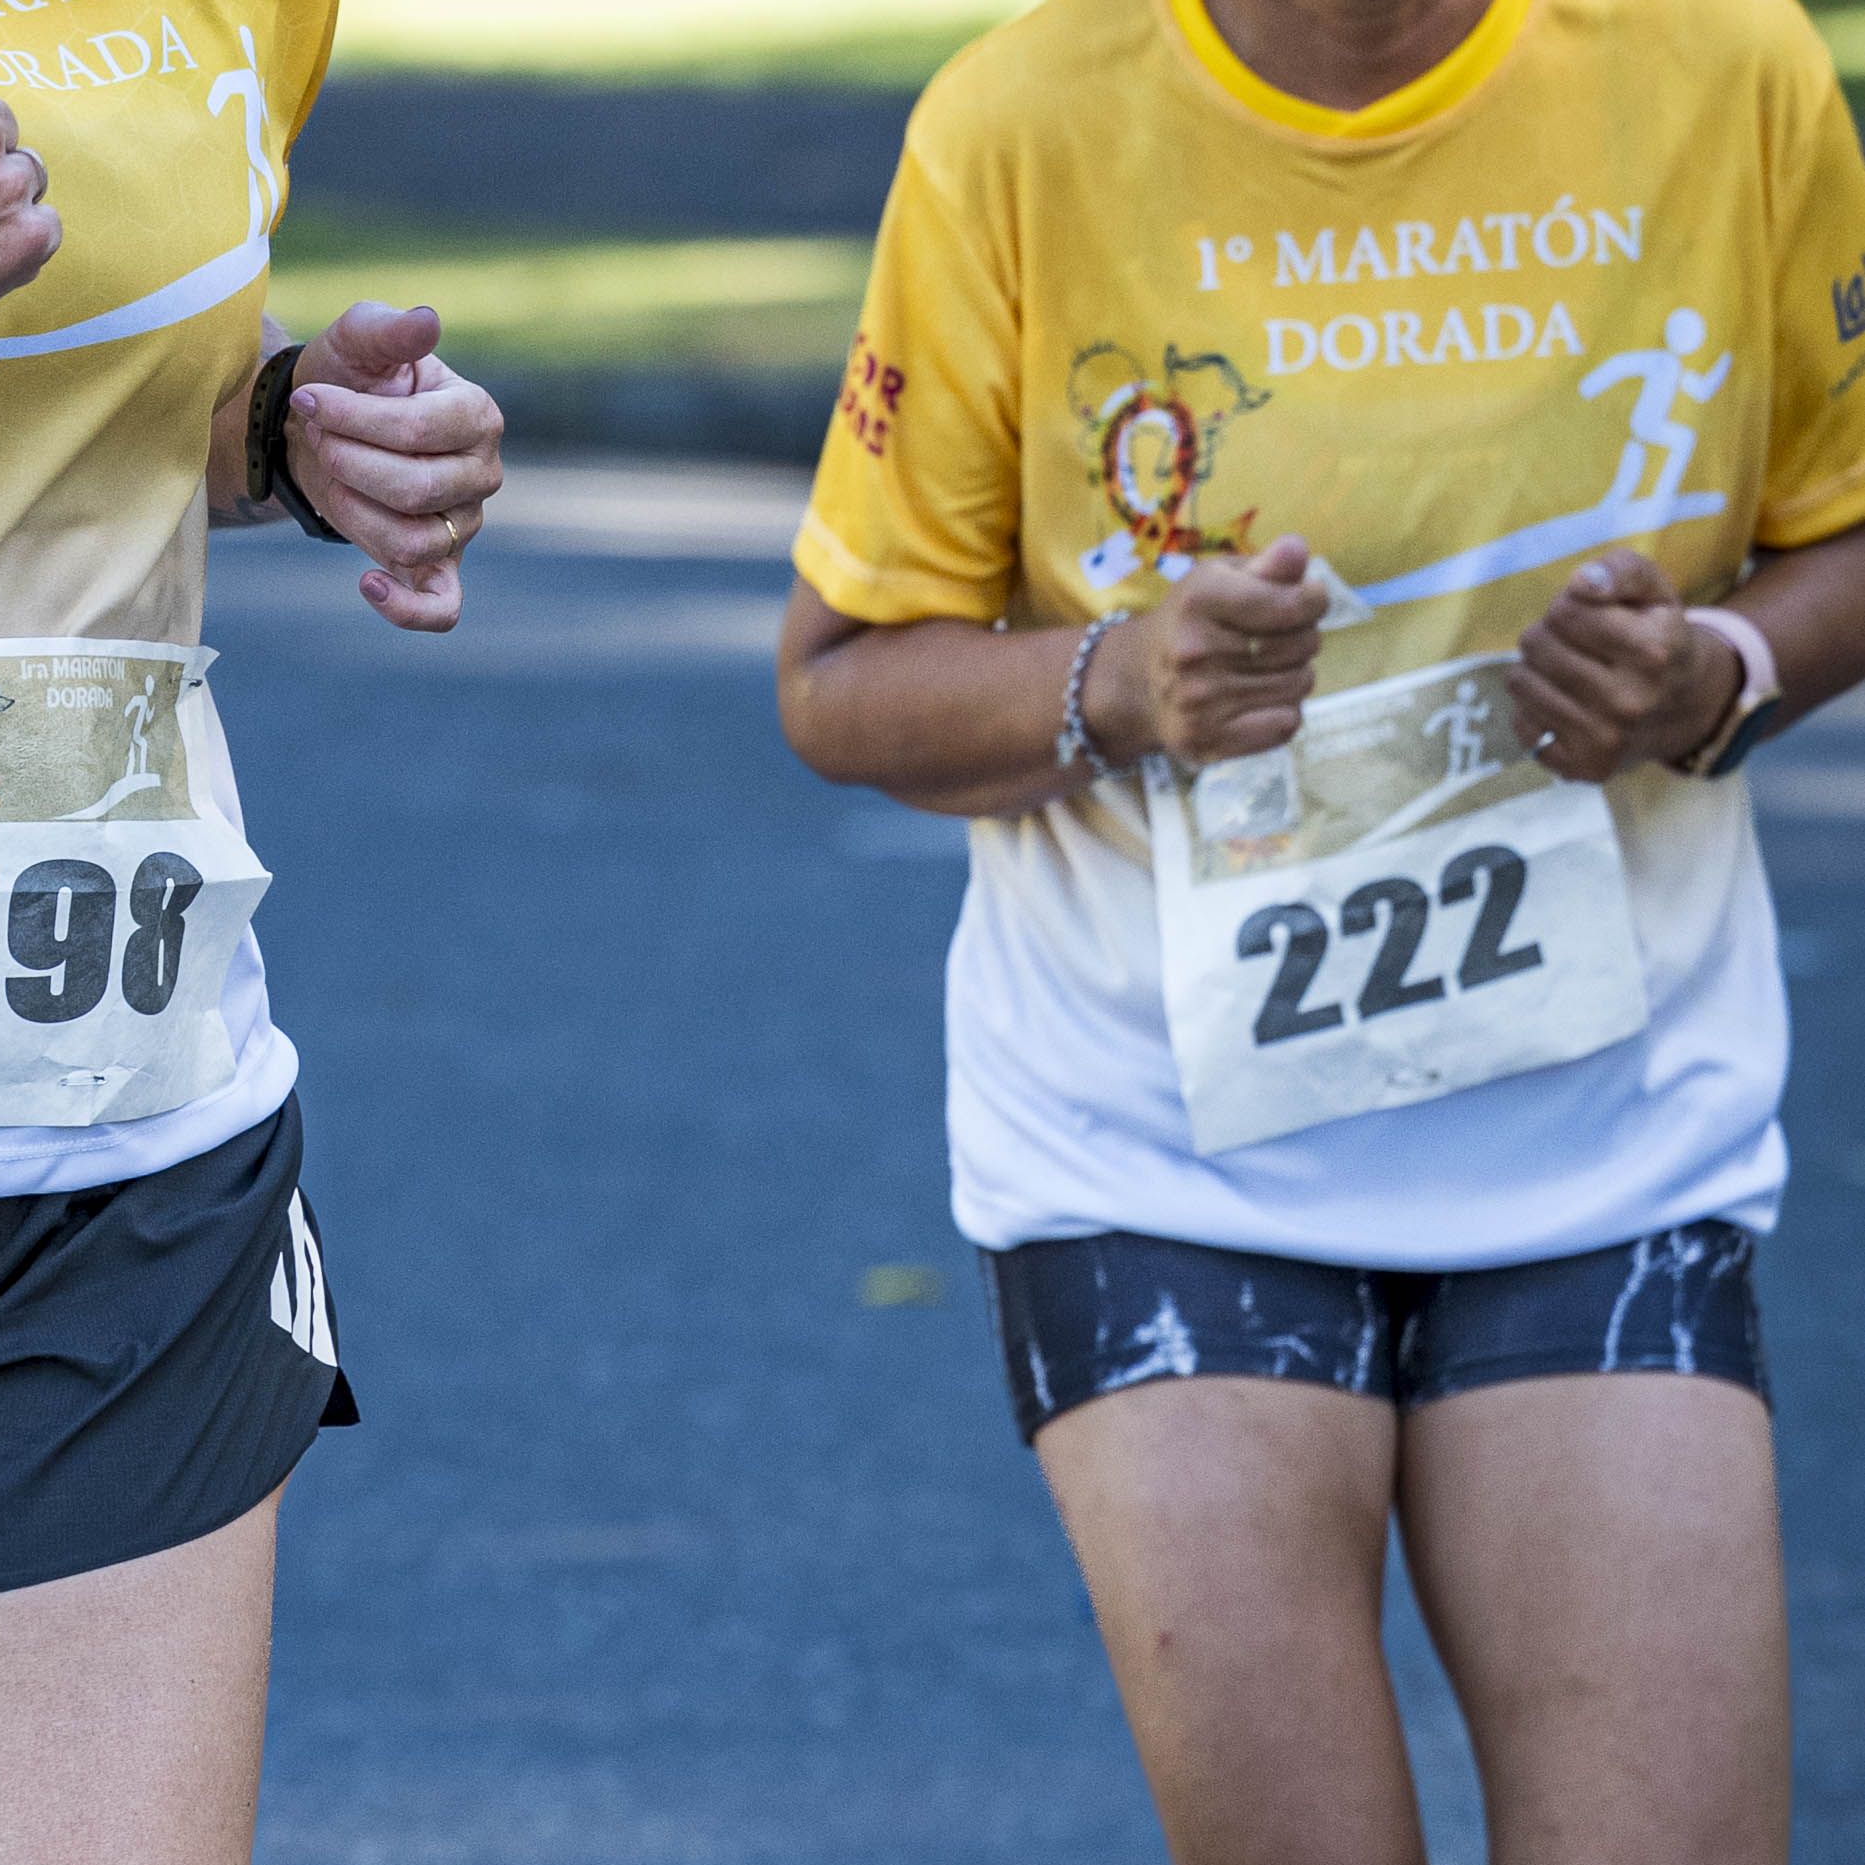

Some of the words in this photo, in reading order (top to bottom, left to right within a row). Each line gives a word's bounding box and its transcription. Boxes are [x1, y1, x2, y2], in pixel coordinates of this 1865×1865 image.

[1273, 193, 1644, 288] MARATÓN
[1263, 299, 1585, 377] DORADA
[46, 686, 114, 709] DORADA
[1235, 844, 1545, 1049] 222
